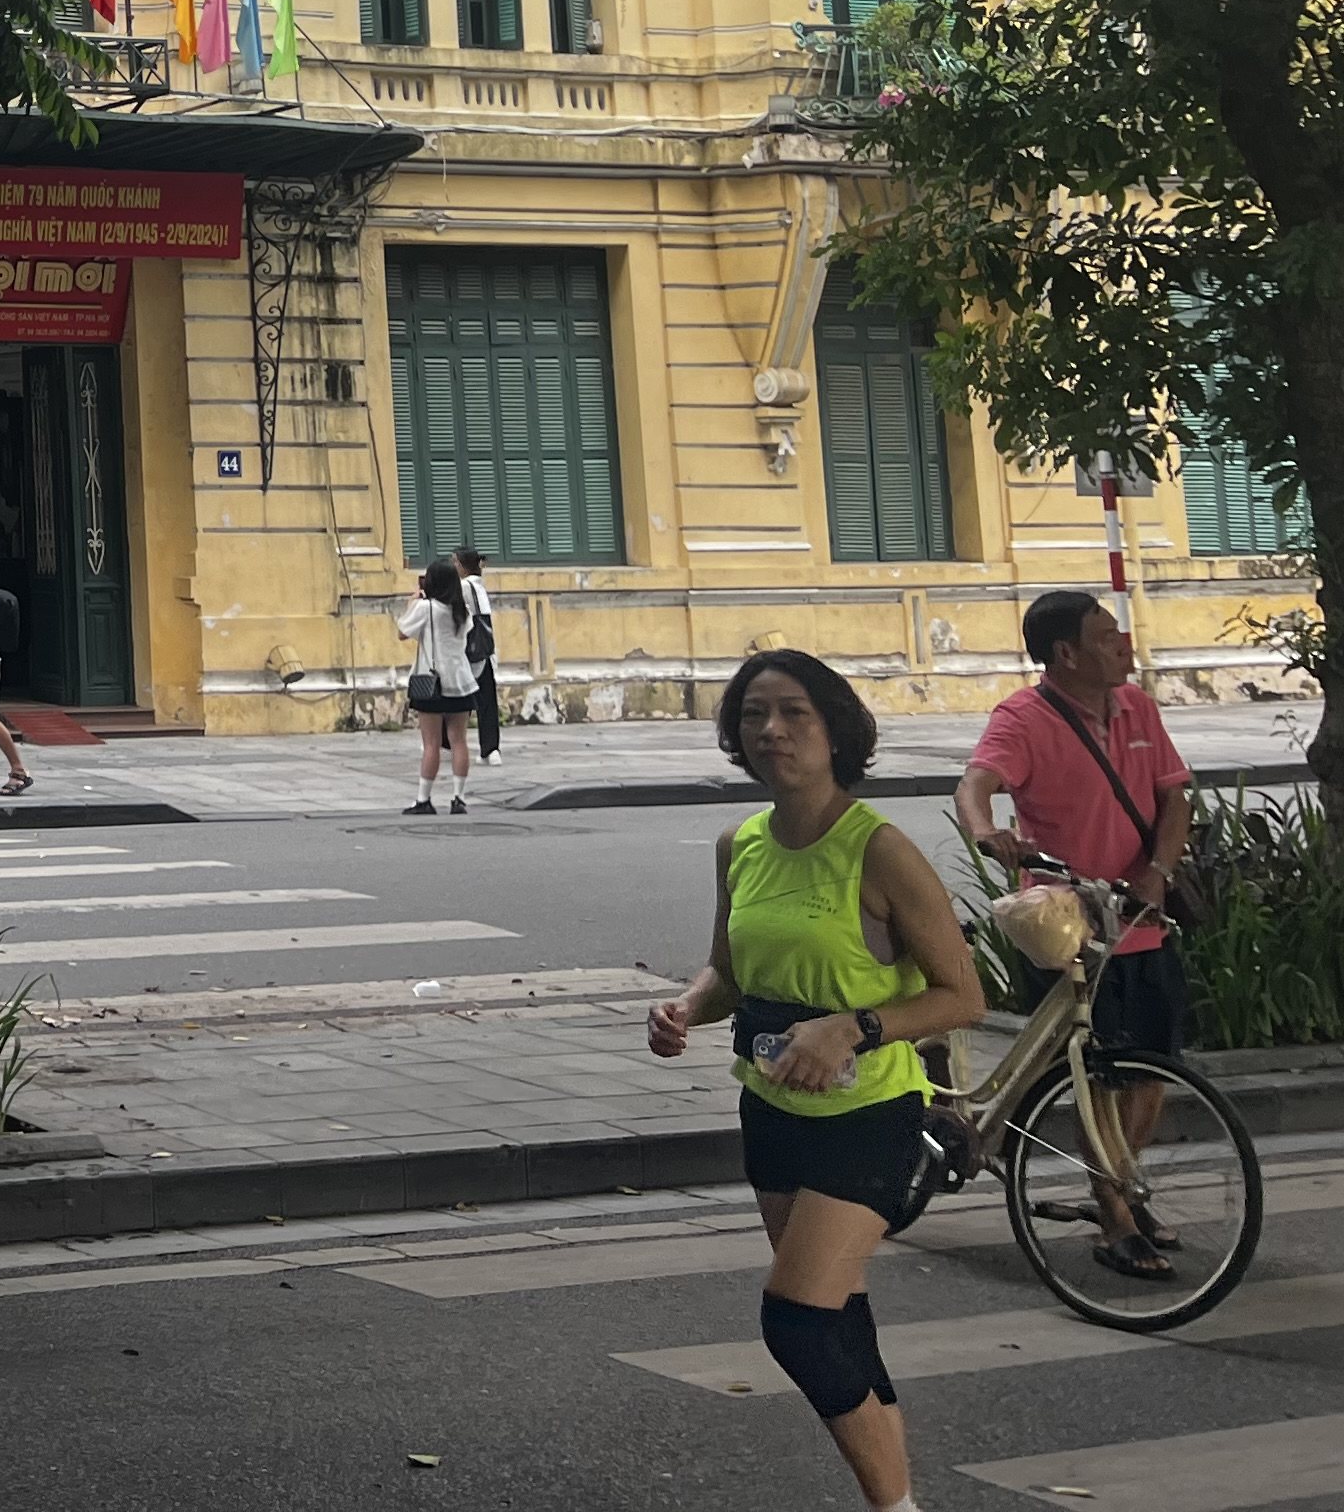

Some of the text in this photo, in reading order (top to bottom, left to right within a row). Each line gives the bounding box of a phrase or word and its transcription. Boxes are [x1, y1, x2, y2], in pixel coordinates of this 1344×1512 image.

[29, 184, 43, 206] 79
[46, 180, 77, 207] NĂM
[80, 179, 114, 210] QUỐC
[118, 183, 161, 209] KHÁNH
[37, 216, 63, 247] VIỆT
[67, 221, 96, 243] NAM
[221, 455, 239, 472] 44
